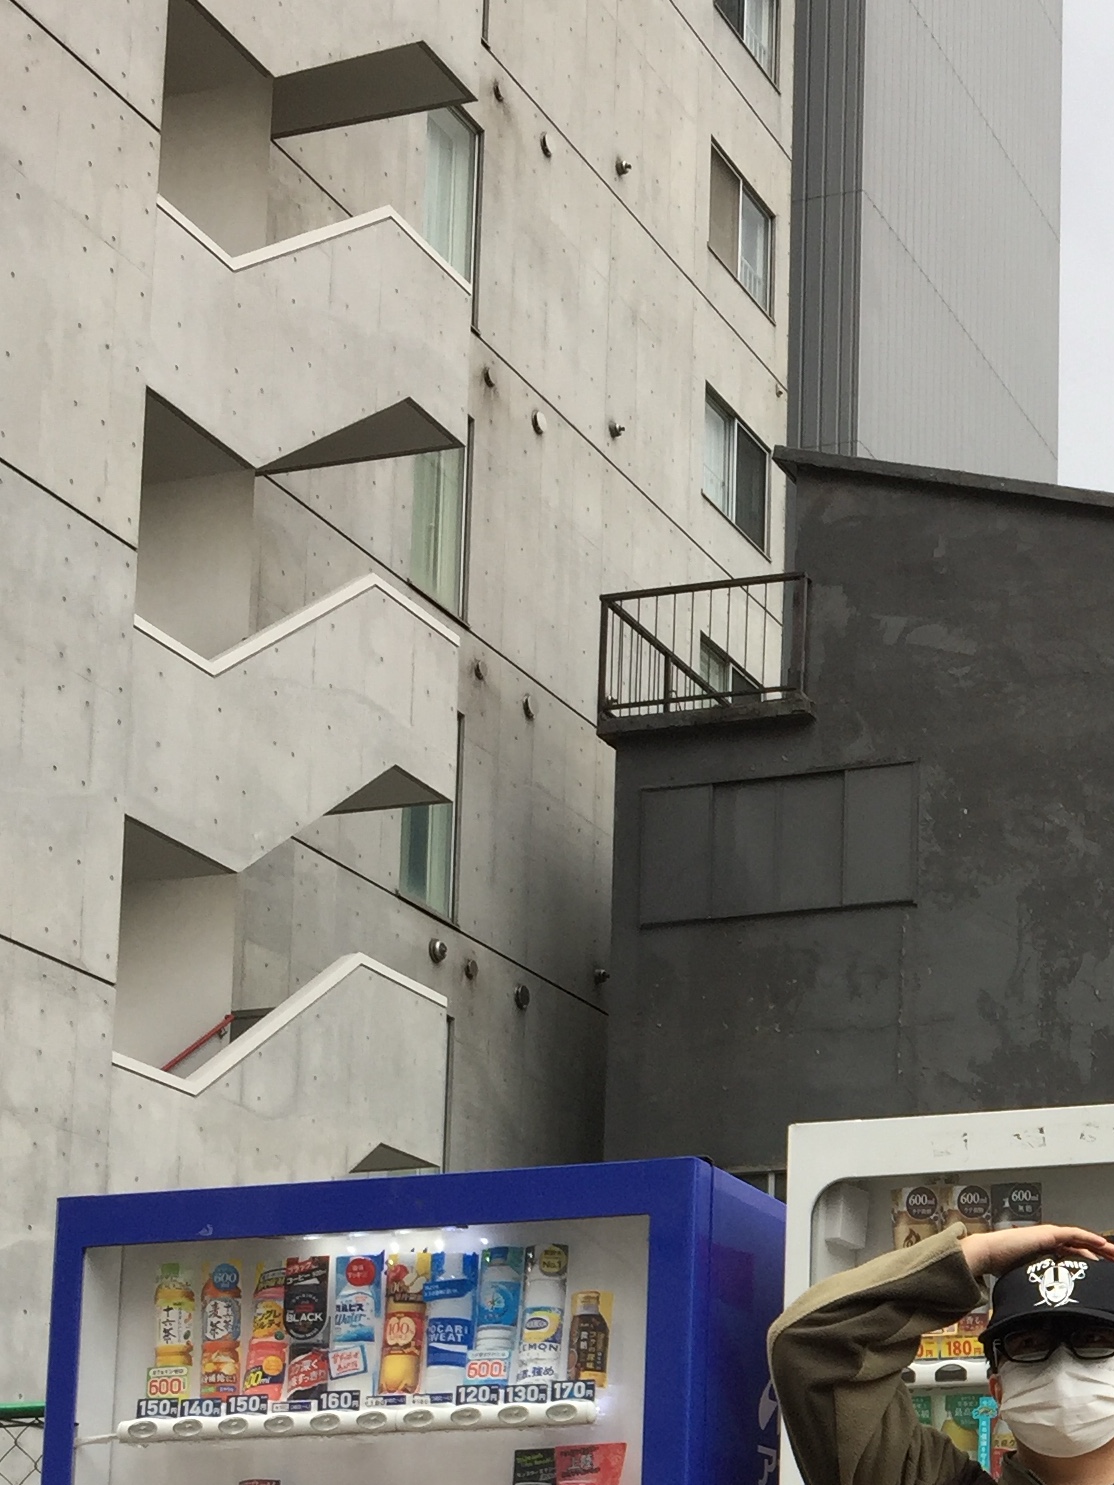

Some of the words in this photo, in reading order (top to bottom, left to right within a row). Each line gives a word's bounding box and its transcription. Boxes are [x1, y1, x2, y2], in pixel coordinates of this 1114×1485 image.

[161, 1305, 176, 1345] 十六茶
[945, 1340, 983, 1357] 180円
[458, 1385, 499, 1402] 120円
[506, 1385, 547, 1402] 130円
[554, 1382, 595, 1398] 170円
[139, 1400, 178, 1416] 150円
[182, 1401, 220, 1416] 140円
[229, 1396, 268, 1412] 150円
[321, 1392, 360, 1409] 160円
